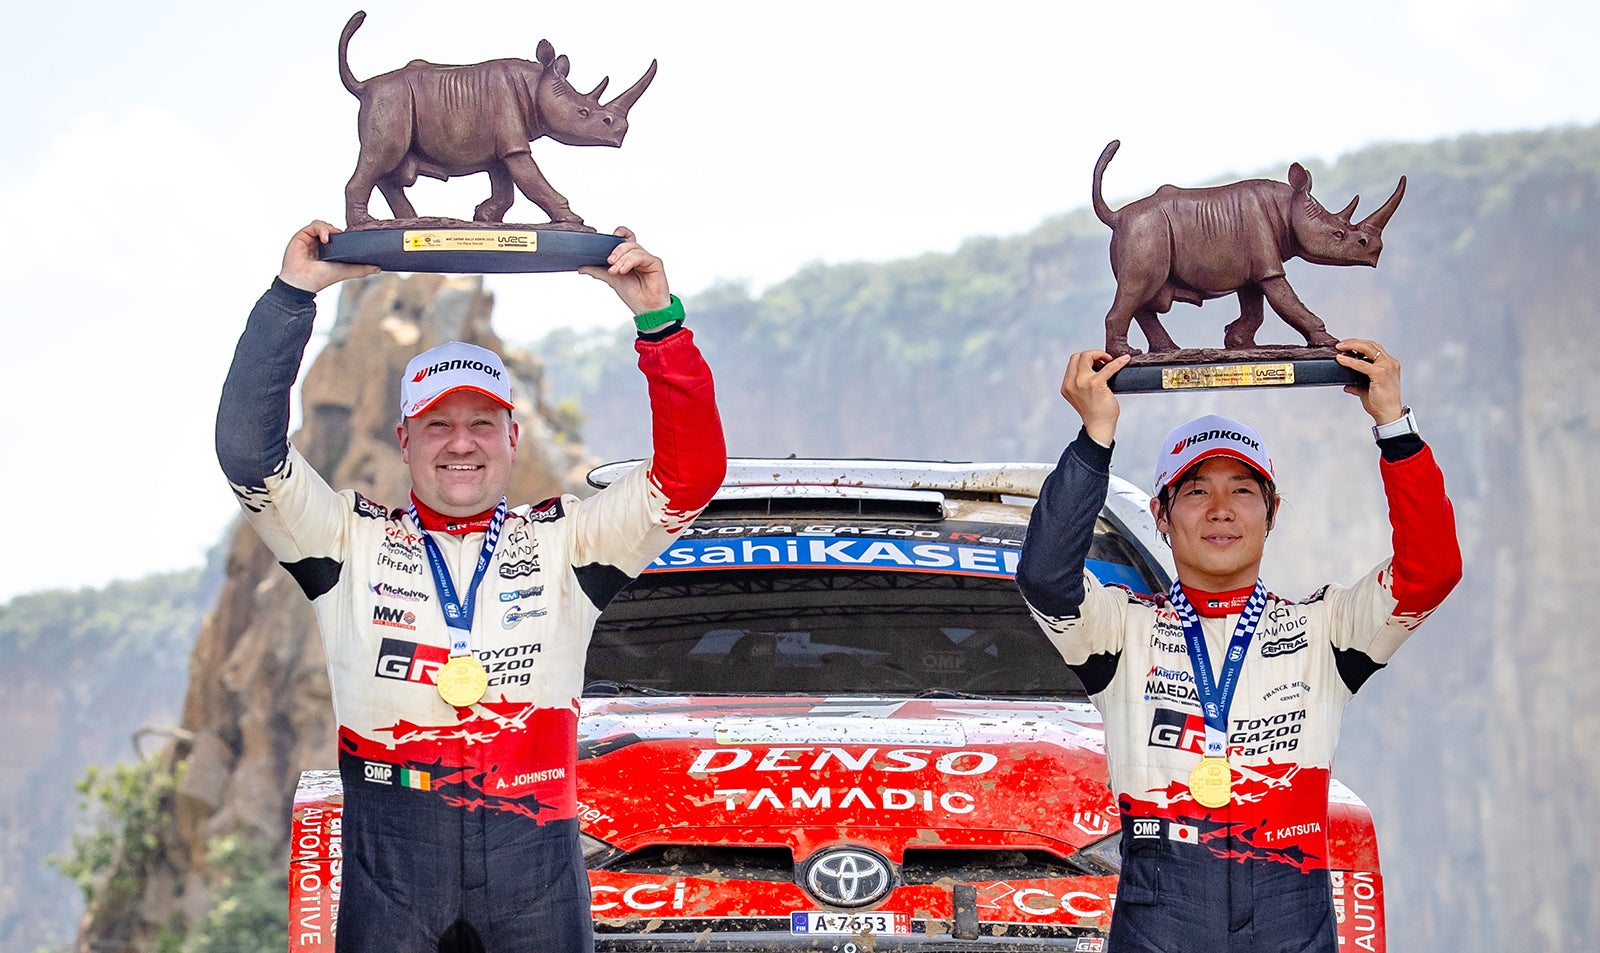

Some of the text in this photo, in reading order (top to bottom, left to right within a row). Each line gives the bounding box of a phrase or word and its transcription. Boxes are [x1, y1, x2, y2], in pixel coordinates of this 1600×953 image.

[803, 525, 940, 538] GAZOO
[383, 583, 430, 601] McKelvey
[373, 605, 405, 622] MW
[454, 642, 467, 650] FIA
[487, 673, 531, 687] cing
[1144, 681, 1201, 702] MAEDA
[1262, 684, 1288, 701] FRANCK
[1207, 702, 1218, 718] FIA
[1233, 709, 1306, 731] TOYOTA
[1229, 724, 1301, 744] GAZOO
[1208, 743, 1222, 751] FIA
[1228, 738, 1299, 757] Racing
[687, 747, 998, 775] DENSO
[364, 765, 393, 781] OMP
[496, 768, 565, 789] A. JOHNSTON
[713, 787, 976, 814] TAMADIC
[1133, 822, 1161, 835] OMP
[1264, 822, 1321, 843] T. KATSUTA
[299, 807, 322, 946] AUTOMOTIVE
[895, 914, 906, 922] 11
[895, 925, 907, 934] 26
[1078, 942, 1101, 951] GR
